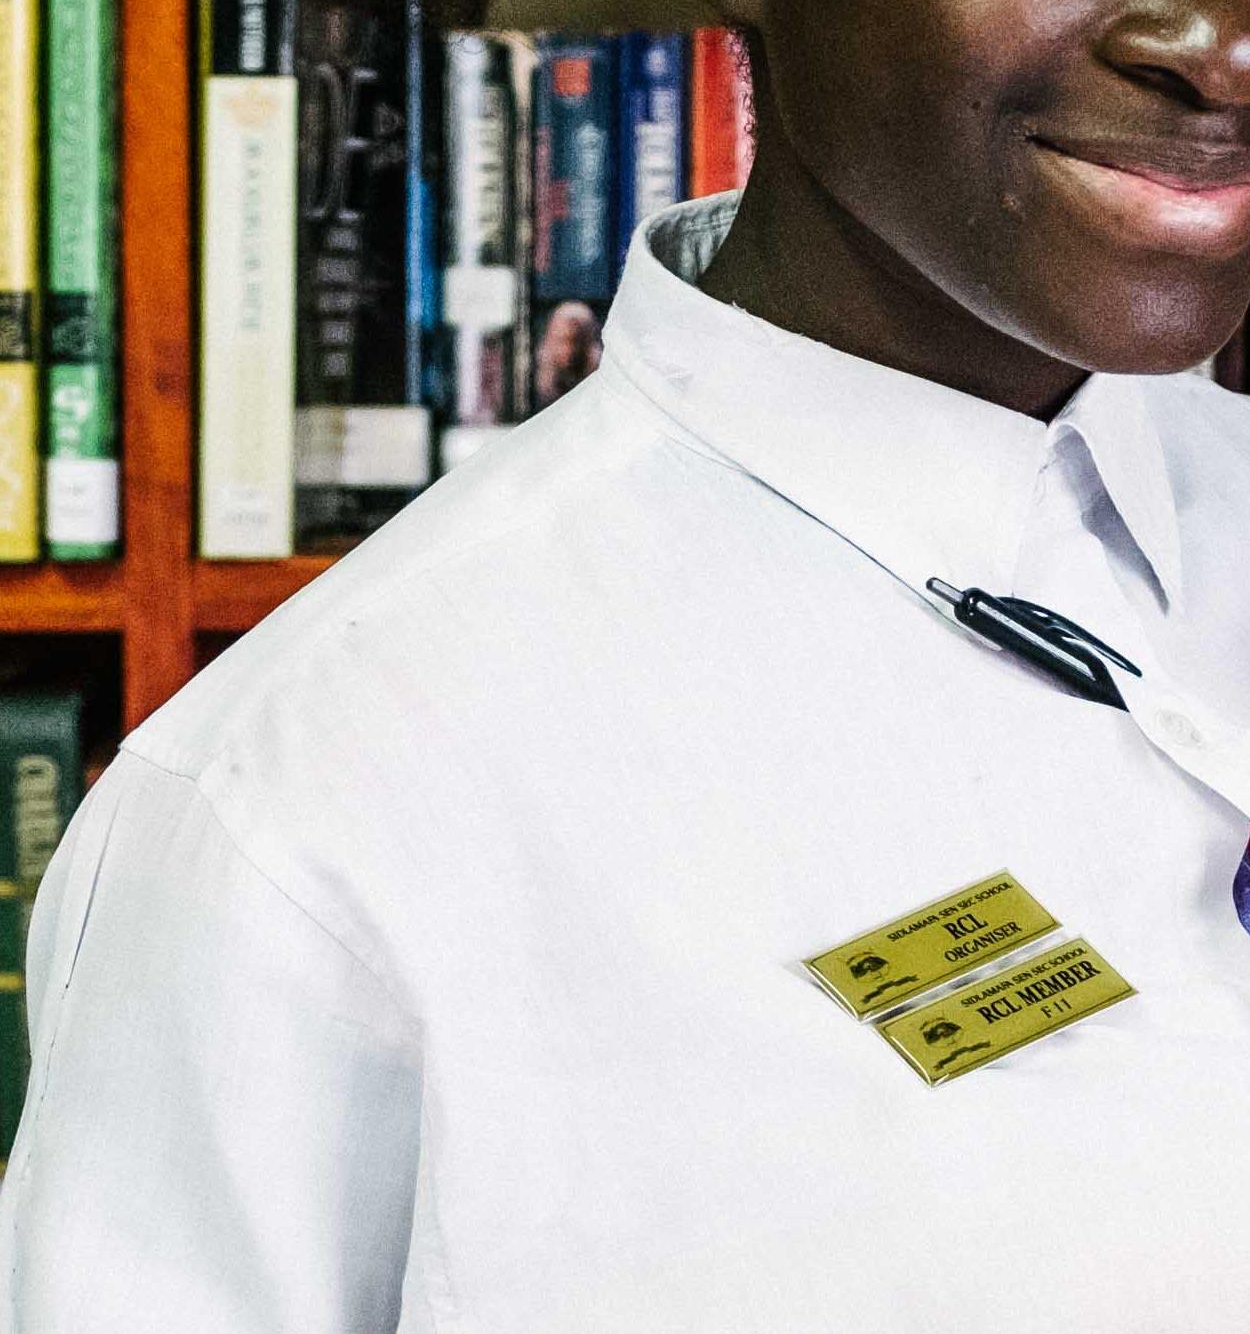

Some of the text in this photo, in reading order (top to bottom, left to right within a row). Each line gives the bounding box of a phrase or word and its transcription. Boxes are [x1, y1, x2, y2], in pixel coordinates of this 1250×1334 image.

[974, 882, 1013, 903] SCHOOL
[942, 913, 988, 940] RCL
[944, 921, 1022, 962] ORGANISER
[1012, 970, 1033, 984] SEN
[1031, 962, 1051, 976] SEC
[1050, 947, 1087, 968] SCHOOL
[976, 960, 1101, 1024] RCL MEMBER
